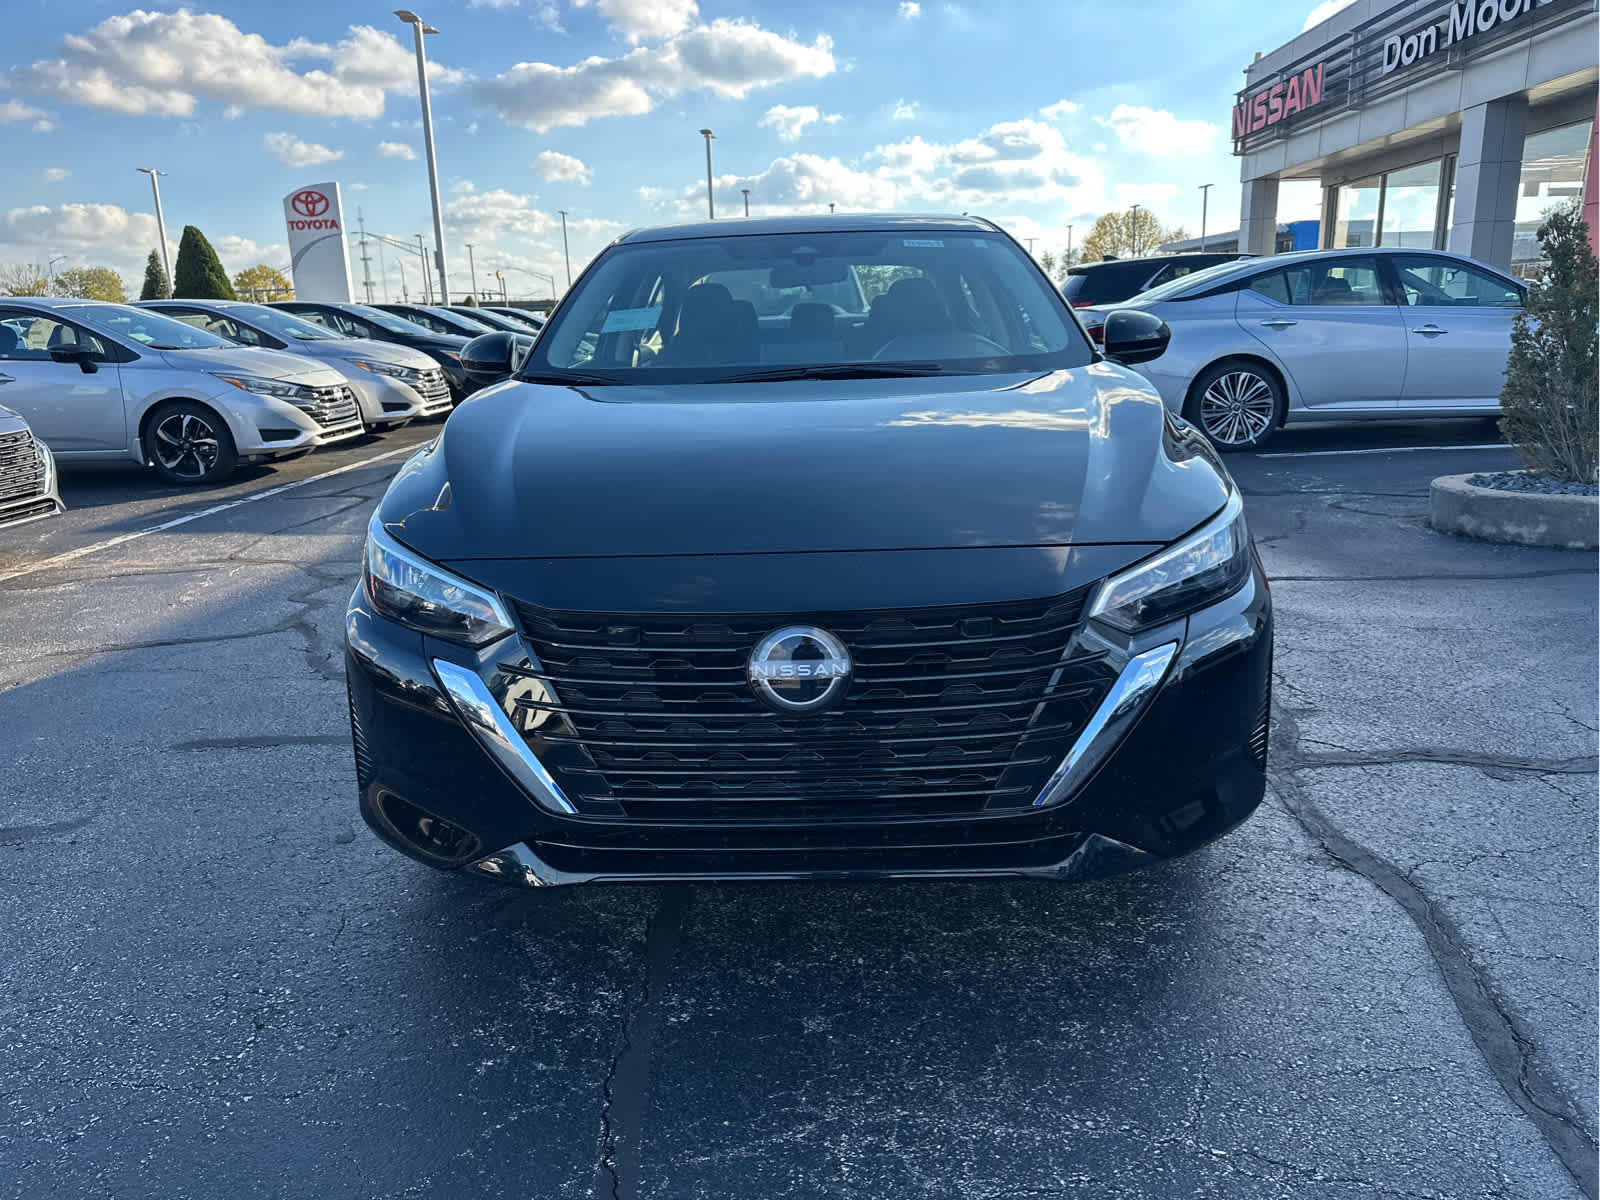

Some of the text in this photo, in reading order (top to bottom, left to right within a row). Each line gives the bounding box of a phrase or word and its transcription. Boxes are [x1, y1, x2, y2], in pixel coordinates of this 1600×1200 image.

[1382, 25, 1436, 74] Don
[1231, 62, 1323, 140] NISSAN
[288, 219, 339, 231] TOYOTA
[752, 662, 847, 677] NISSAN
